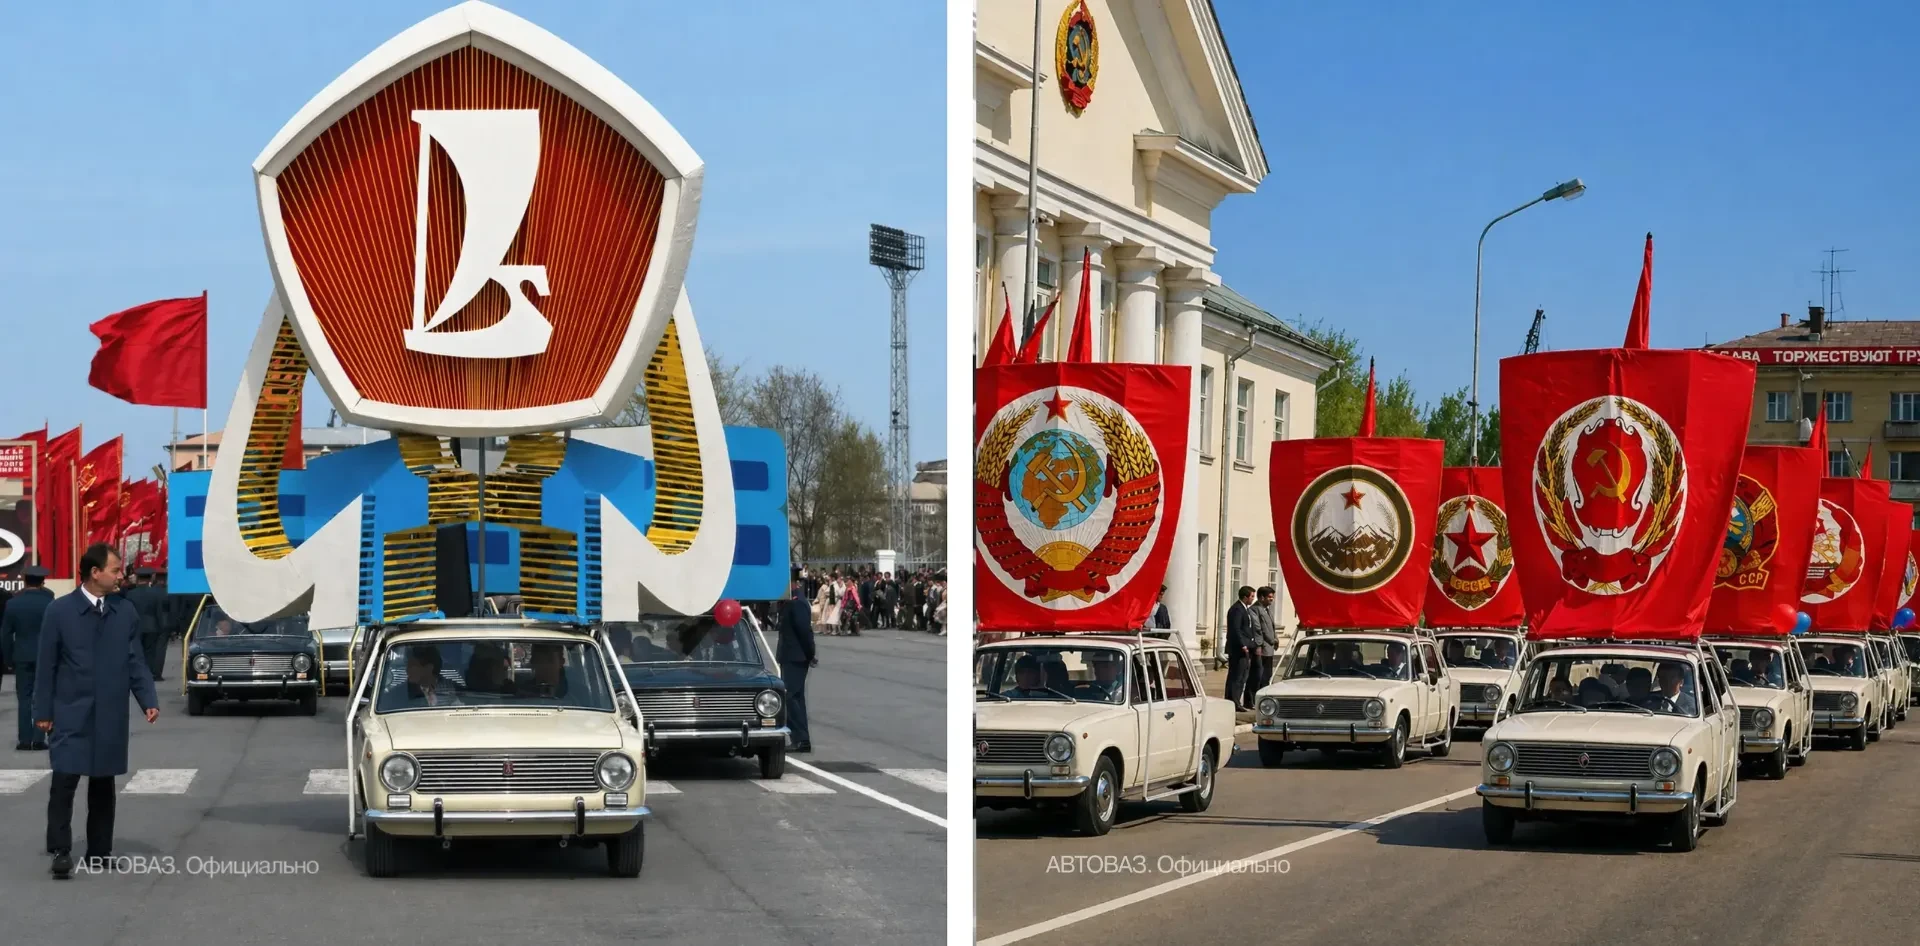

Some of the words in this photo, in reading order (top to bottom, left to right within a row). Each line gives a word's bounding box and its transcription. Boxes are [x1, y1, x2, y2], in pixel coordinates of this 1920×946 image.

[1772, 350, 1893, 363] ТОРЖЕСТВУЮТ
[1455, 578, 1487, 592] СССР
[1739, 572, 1764, 585] ССР
